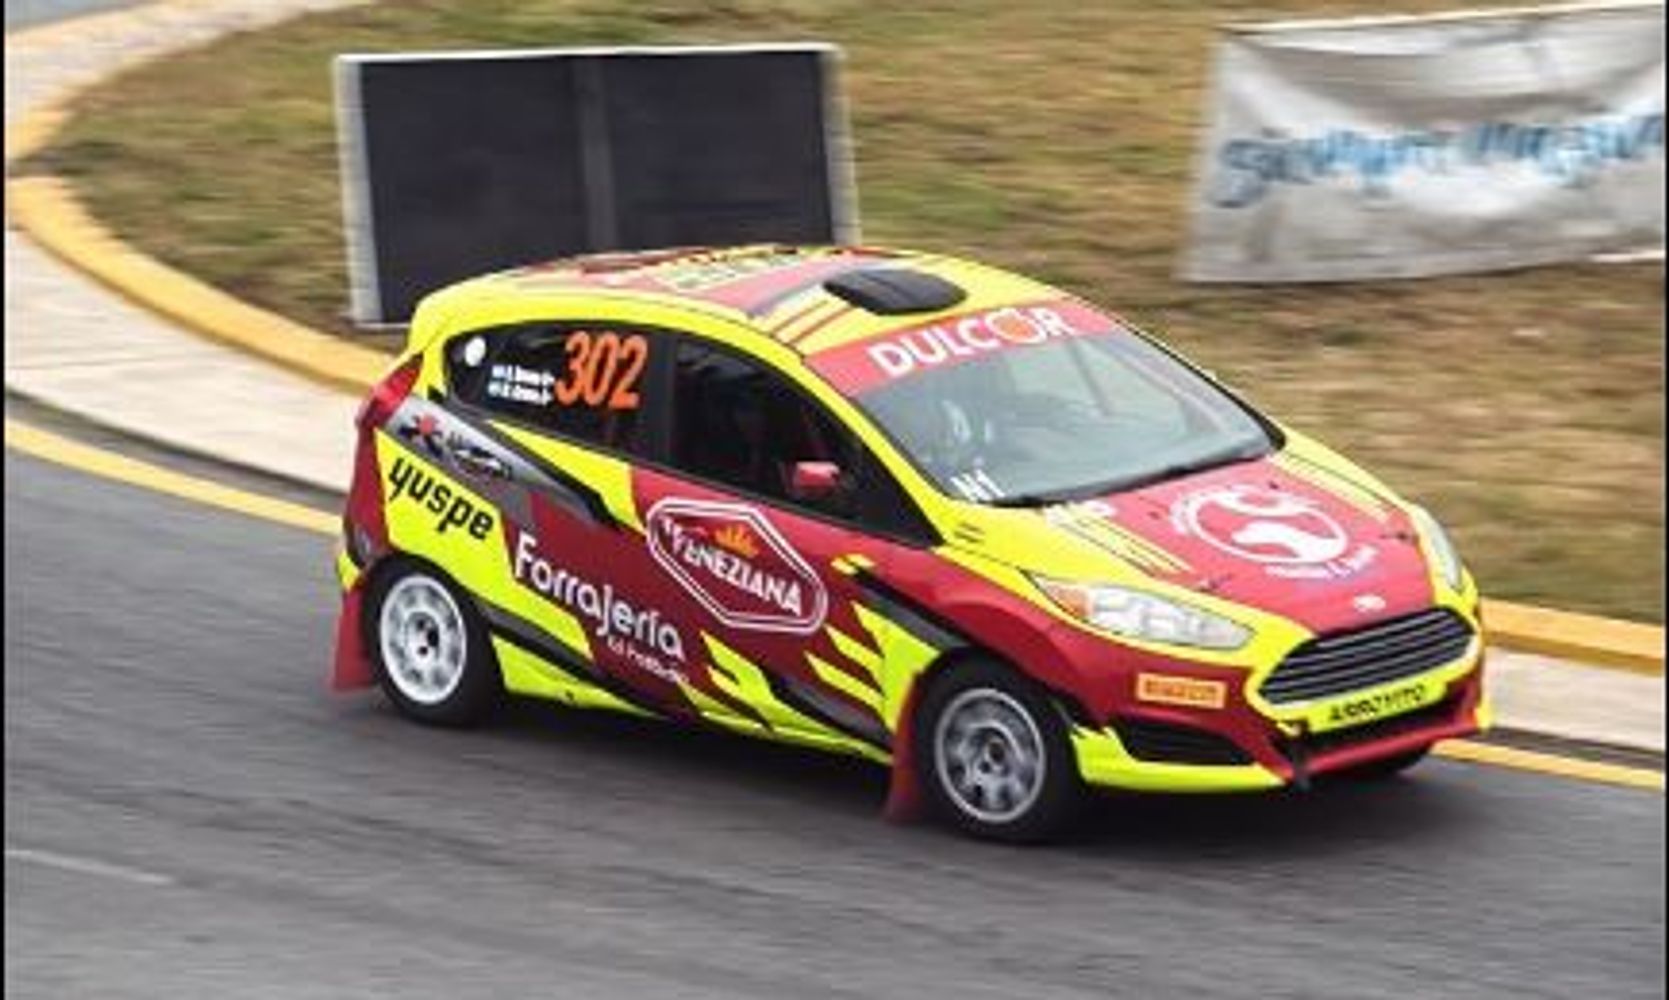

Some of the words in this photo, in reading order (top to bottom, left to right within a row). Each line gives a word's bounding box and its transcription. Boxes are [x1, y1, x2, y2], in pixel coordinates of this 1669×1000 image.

[554, 331, 648, 408] 302
[865, 307, 1077, 378] DULCOR
[388, 457, 494, 540] yuspe
